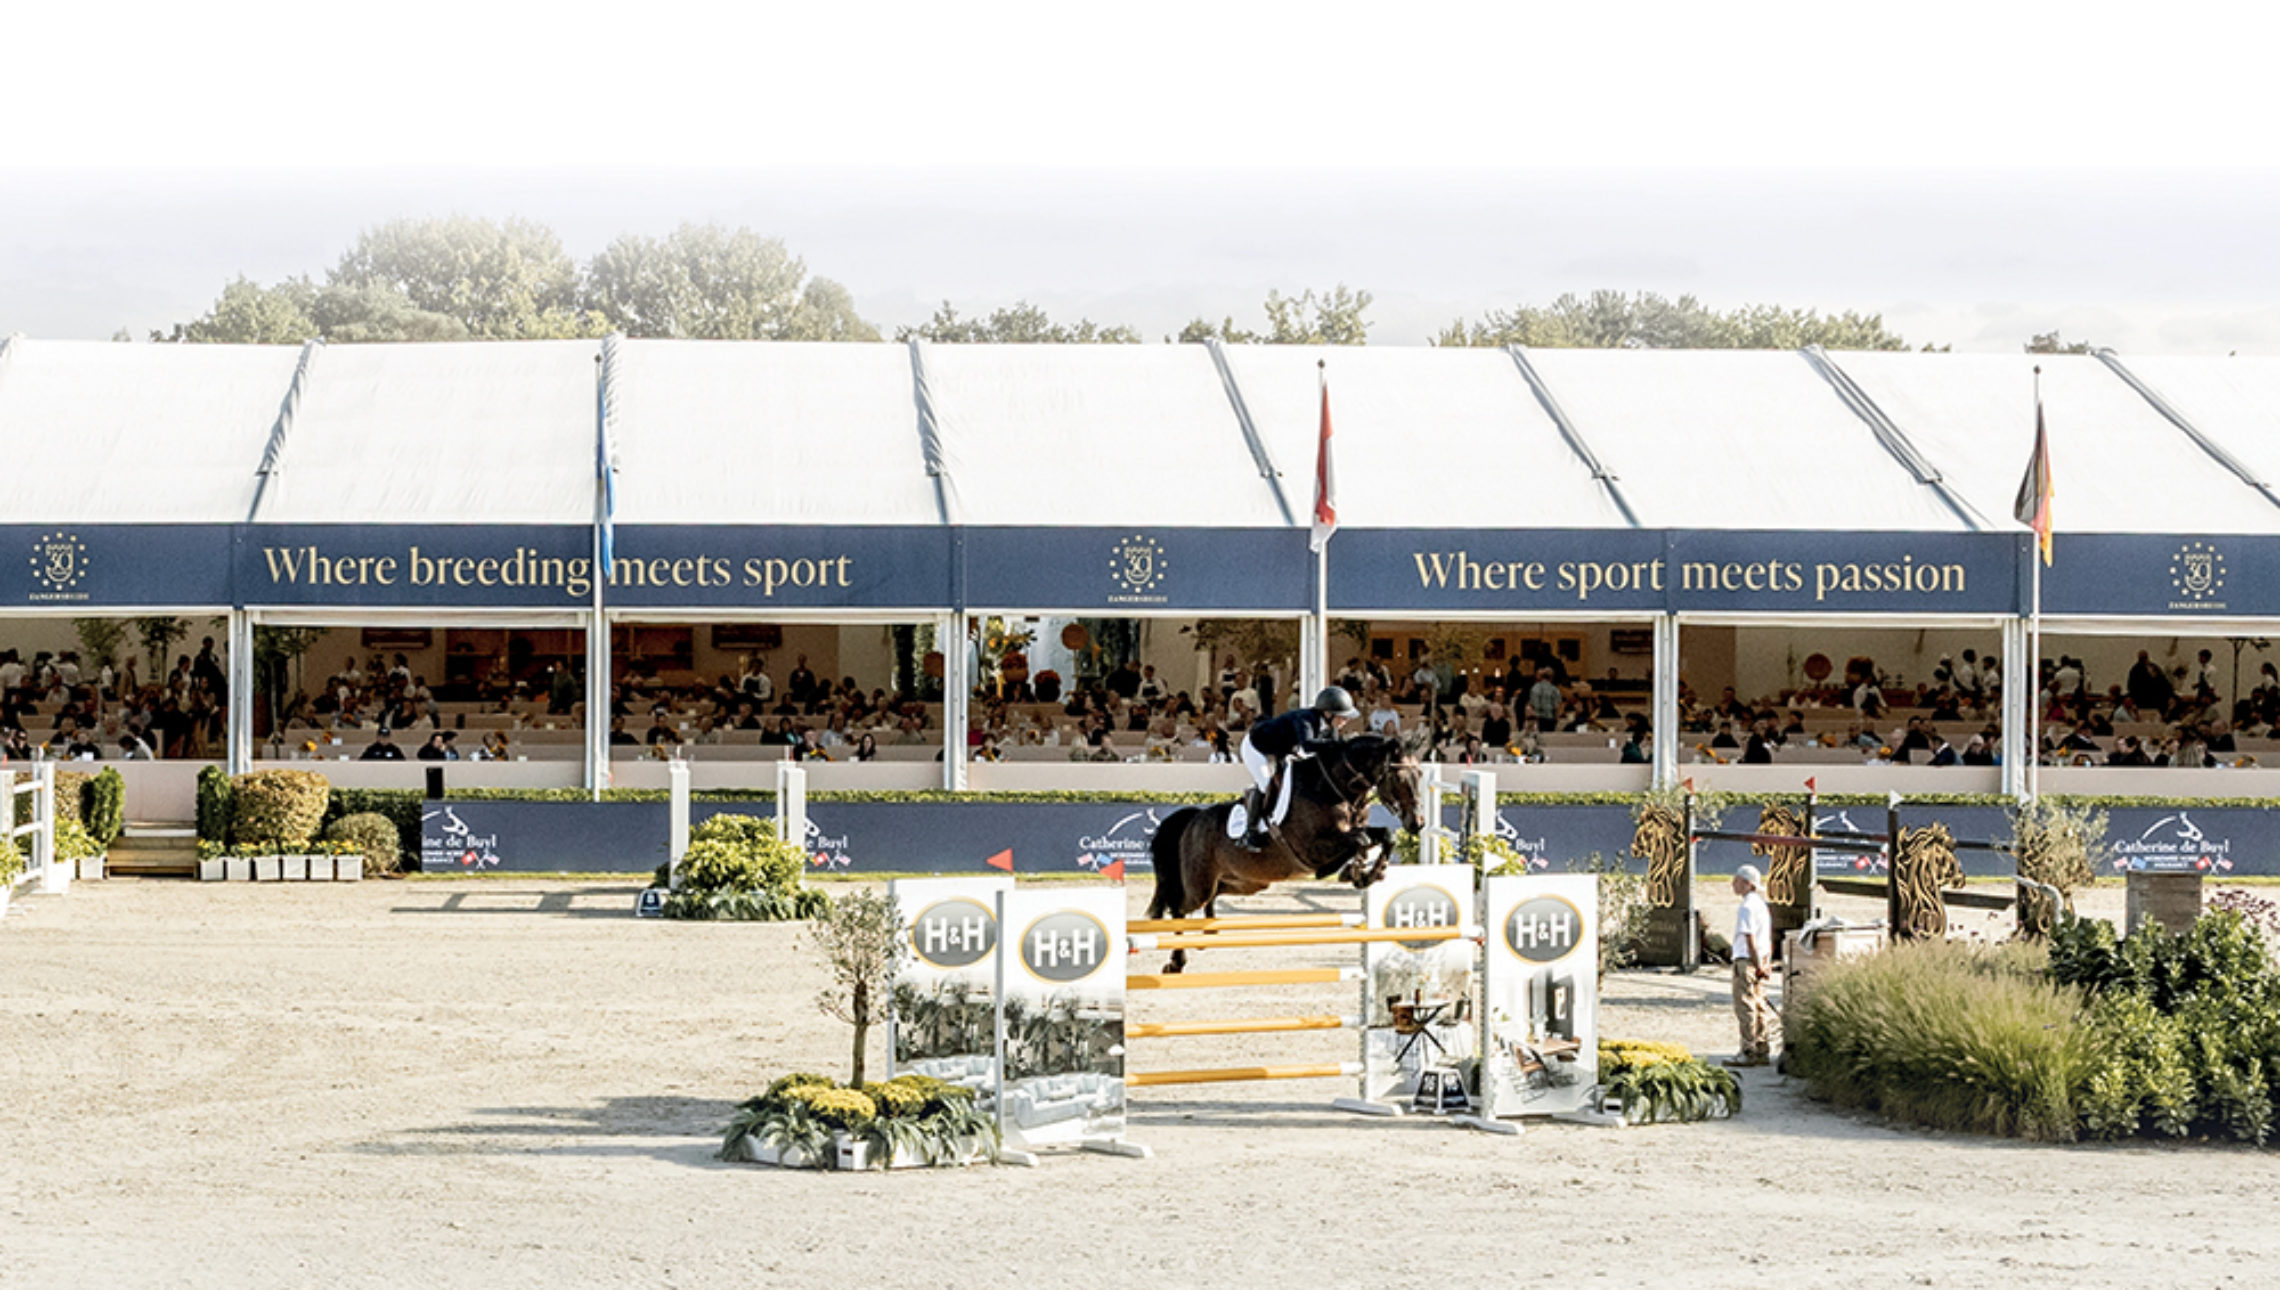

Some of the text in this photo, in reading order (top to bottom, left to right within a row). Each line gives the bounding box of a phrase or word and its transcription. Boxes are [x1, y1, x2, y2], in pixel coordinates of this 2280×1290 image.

[264, 546, 853, 597] Where breeding meets sport
[1413, 550, 1966, 601] Where sport meets passion
[1078, 835, 1145, 850] Catherine
[2114, 840, 2178, 853] Catherine
[2180, 840, 2197, 853] de
[1394, 901, 1448, 928] H&H
[1515, 912, 1572, 949] H&H
[924, 916, 986, 953] H&H
[1034, 928, 1096, 967] H&H
